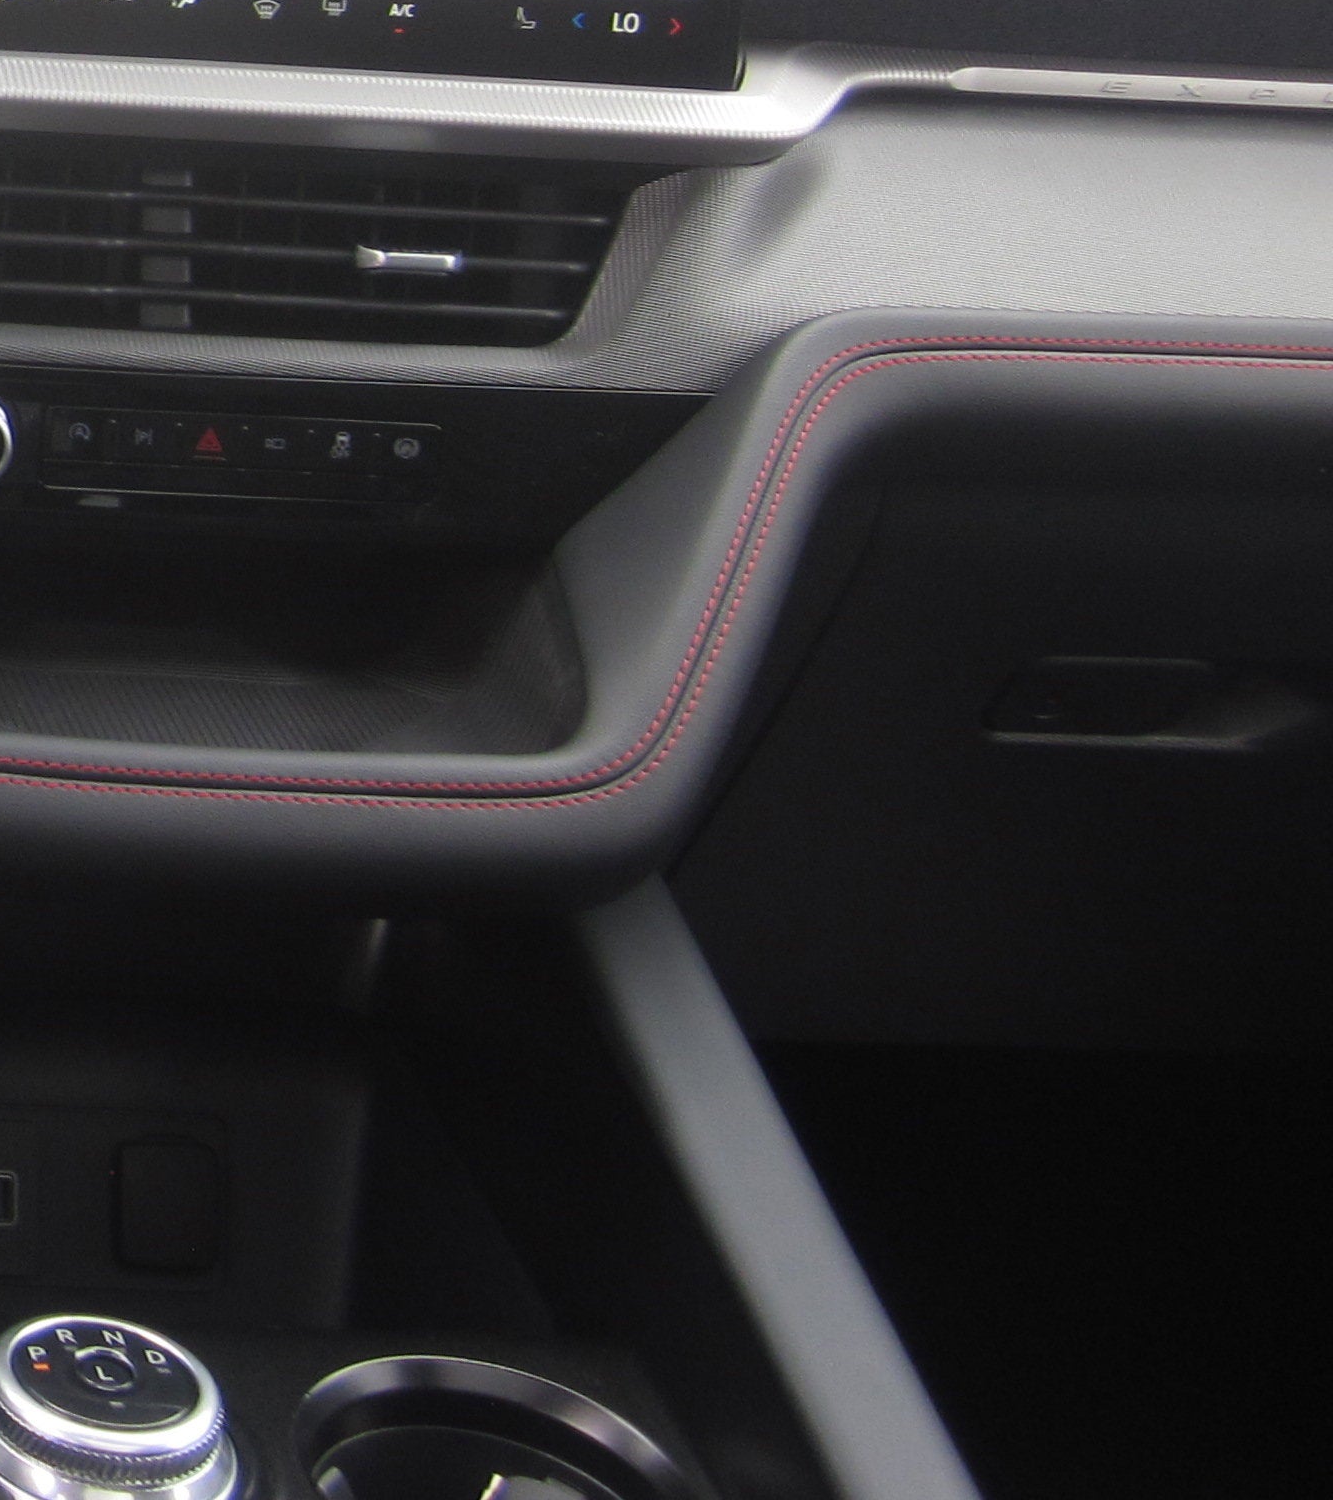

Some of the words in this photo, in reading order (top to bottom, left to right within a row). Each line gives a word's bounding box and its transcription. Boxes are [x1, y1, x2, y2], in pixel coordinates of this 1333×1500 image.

[389, 2, 415, 18] A/C
[612, 12, 640, 34] LO
[27, 1346, 47, 1361] P
[54, 1328, 77, 1344] R
[102, 1329, 126, 1346] N
[145, 1349, 167, 1365] D
[96, 1365, 114, 1382] L
